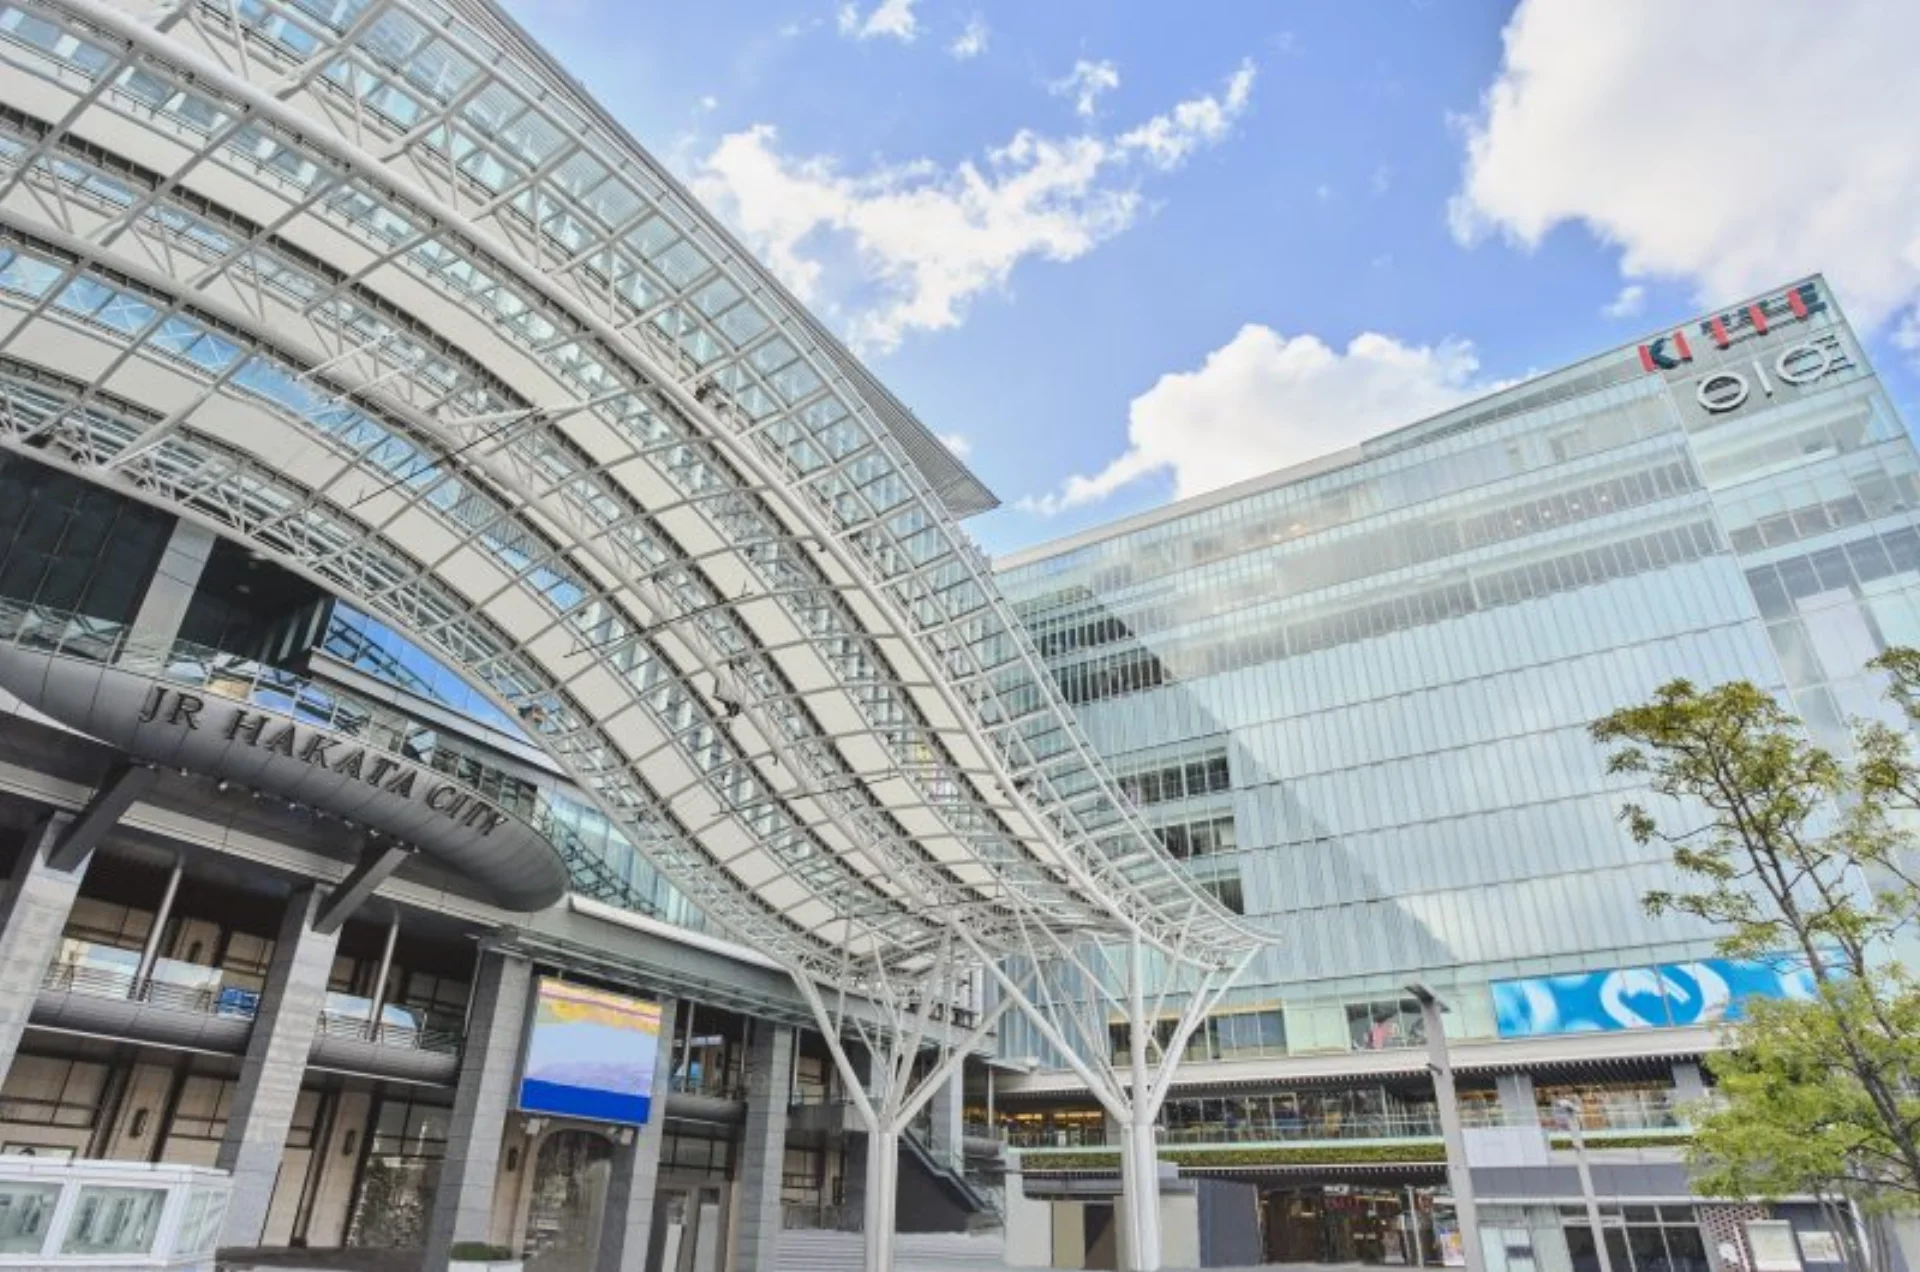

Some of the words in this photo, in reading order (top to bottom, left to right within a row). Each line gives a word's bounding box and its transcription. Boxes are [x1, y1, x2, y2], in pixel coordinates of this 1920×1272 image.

[138, 686, 204, 730] JR
[222, 709, 418, 798] HAKATA
[426, 786, 509, 836] CITY
